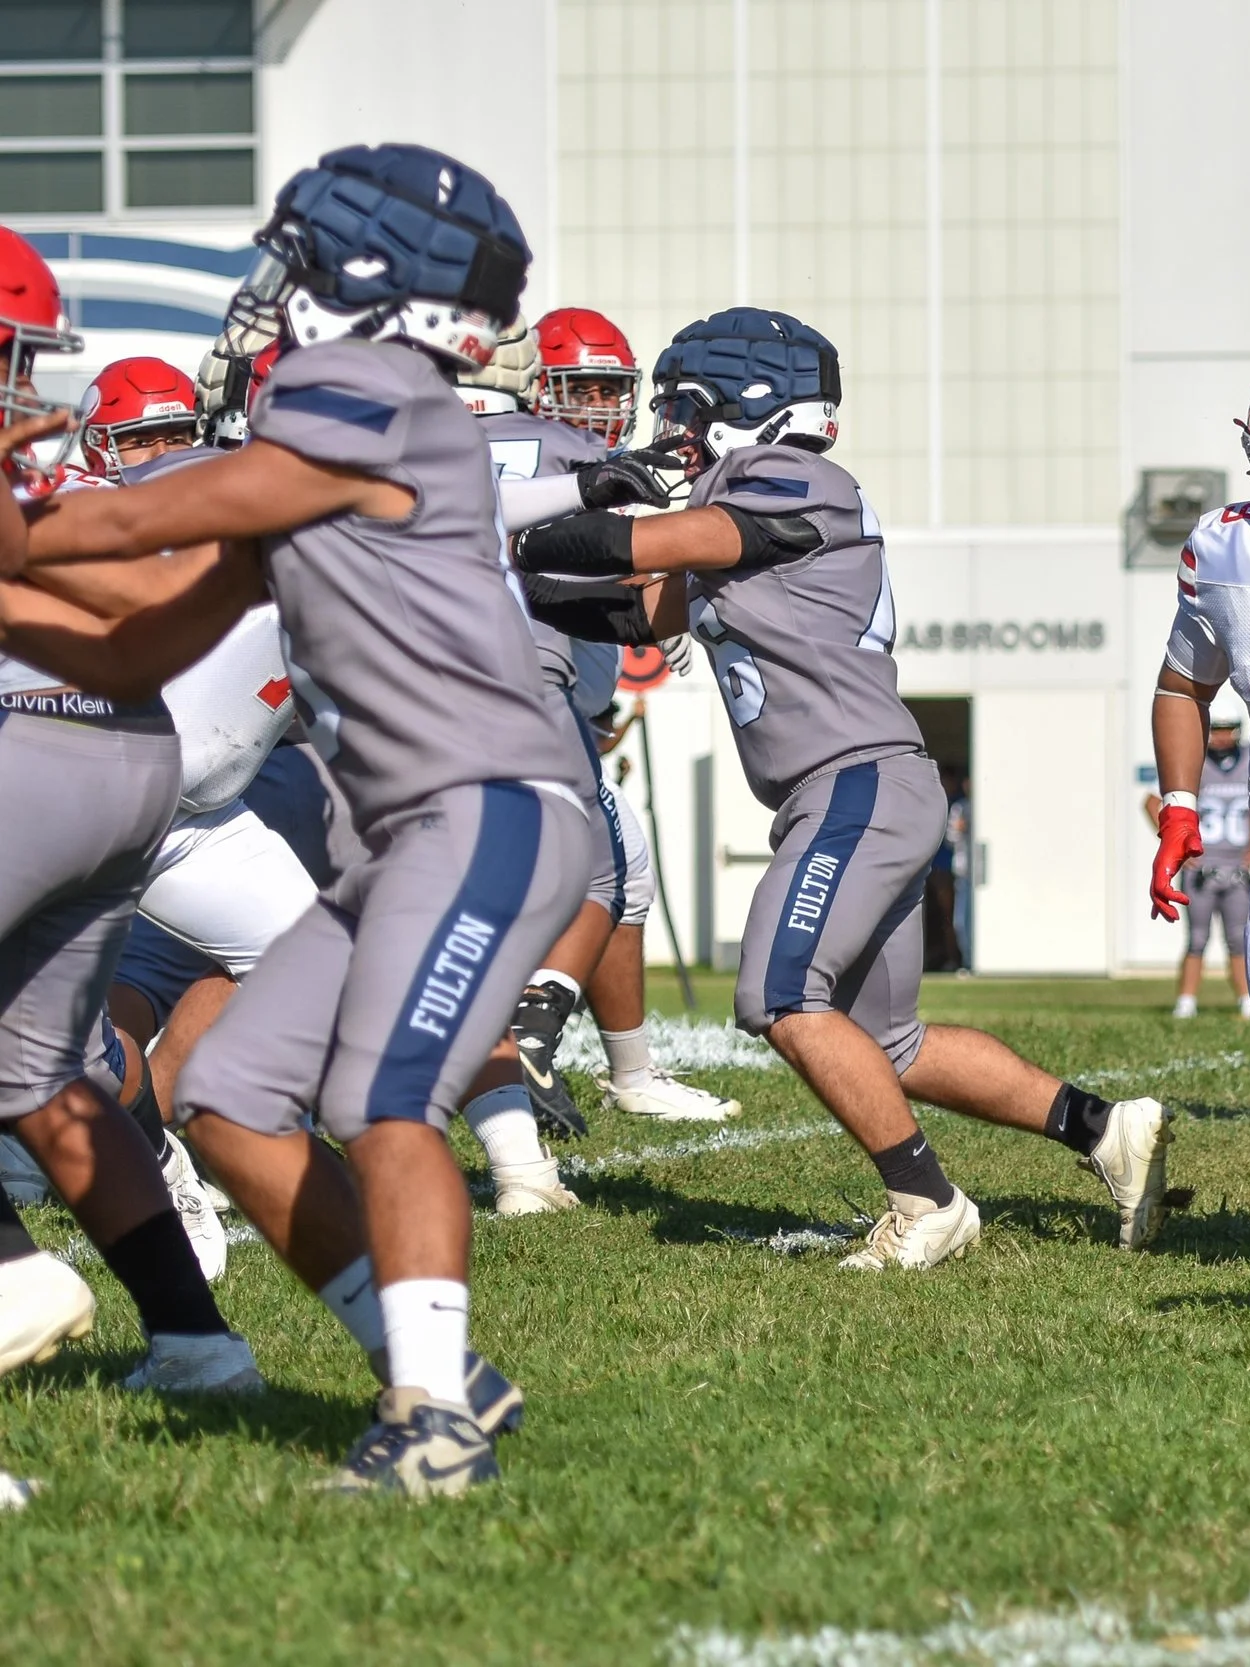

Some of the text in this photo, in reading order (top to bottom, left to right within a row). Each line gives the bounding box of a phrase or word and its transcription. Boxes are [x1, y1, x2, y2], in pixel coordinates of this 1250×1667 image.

[900, 622, 1104, 650] ASSROOMS
[0, 692, 113, 715] alvin Klein
[787, 852, 840, 934] FULTON
[408, 912, 496, 1039] FULTON
